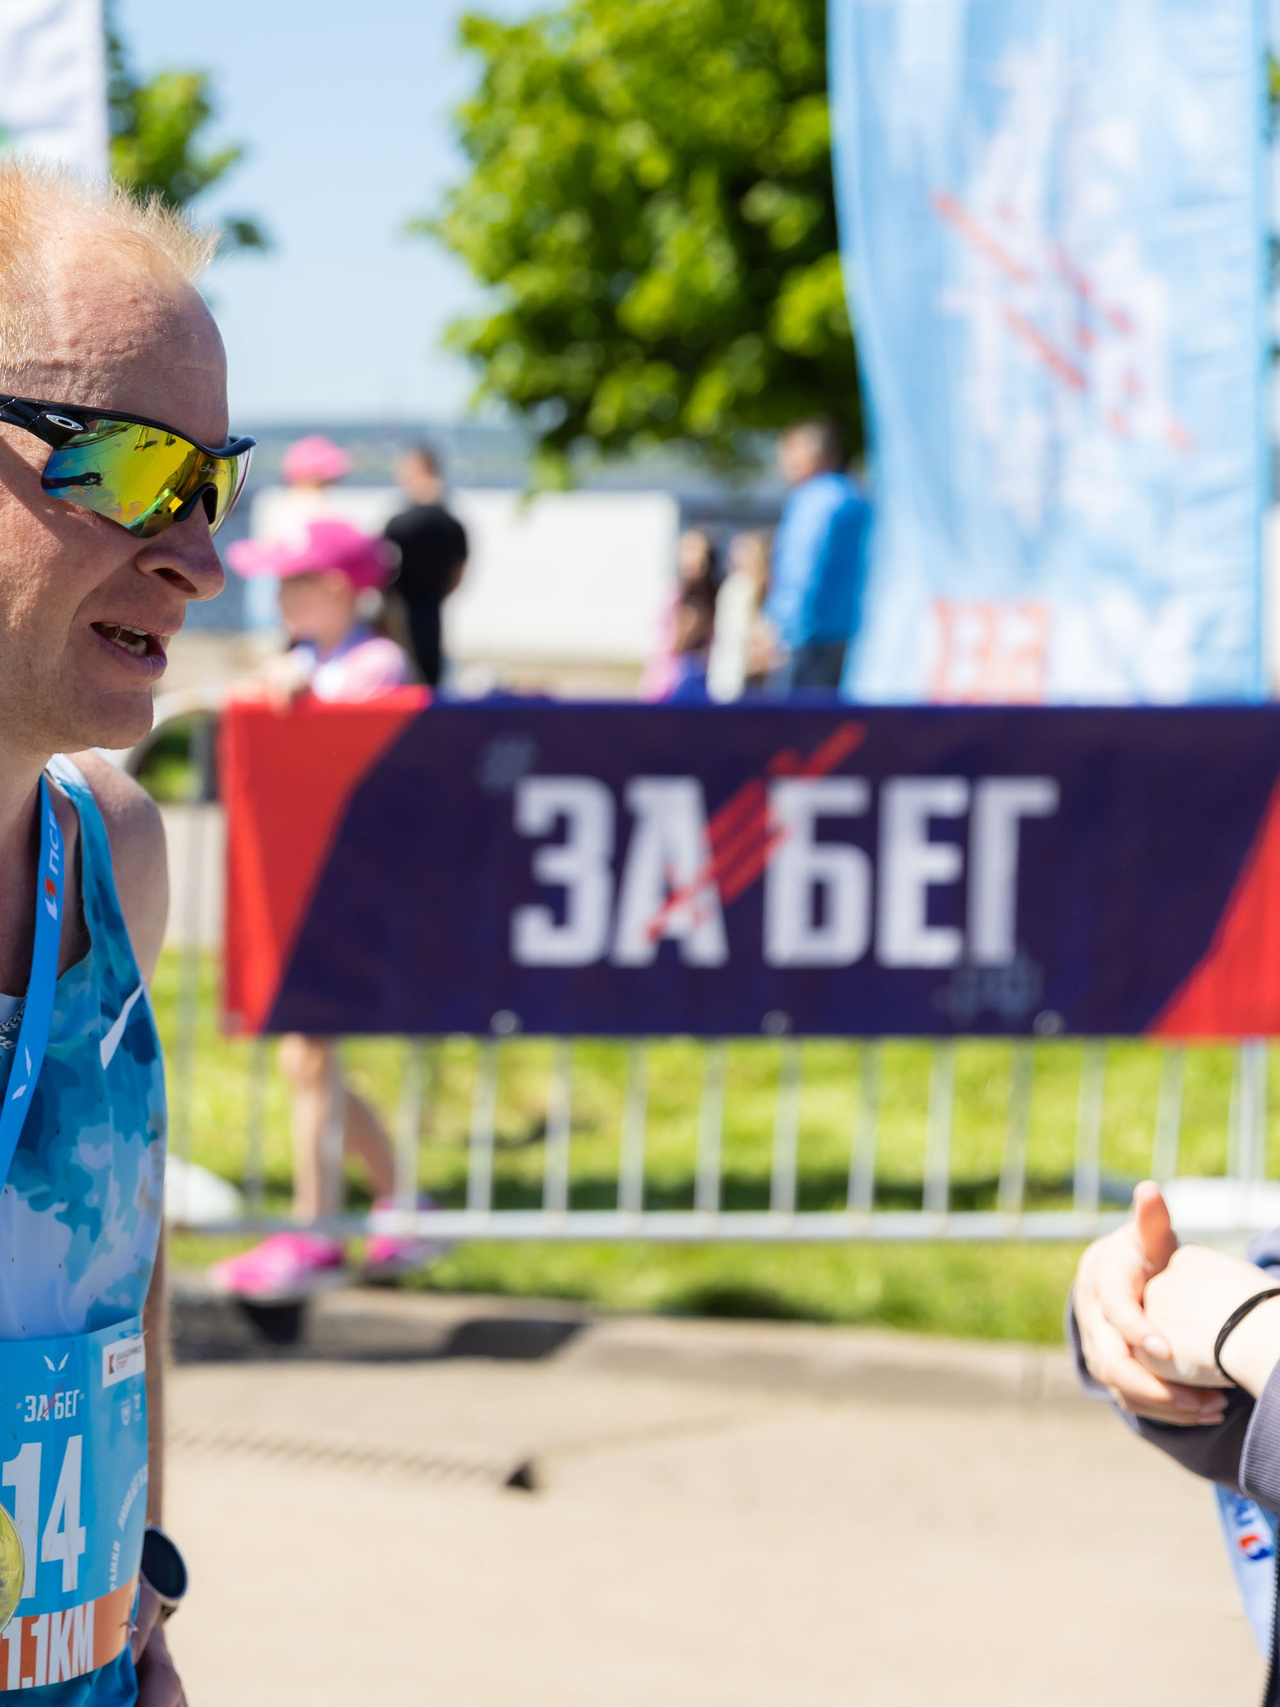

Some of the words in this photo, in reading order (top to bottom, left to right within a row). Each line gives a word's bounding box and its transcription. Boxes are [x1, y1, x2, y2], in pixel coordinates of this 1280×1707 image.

[510, 775, 729, 969] ЗА
[762, 775, 1061, 969] БЕГ
[24, 1394, 50, 1423] ЗА
[54, 1389, 80, 1420] БЕГ
[1, 1434, 87, 1600] 14
